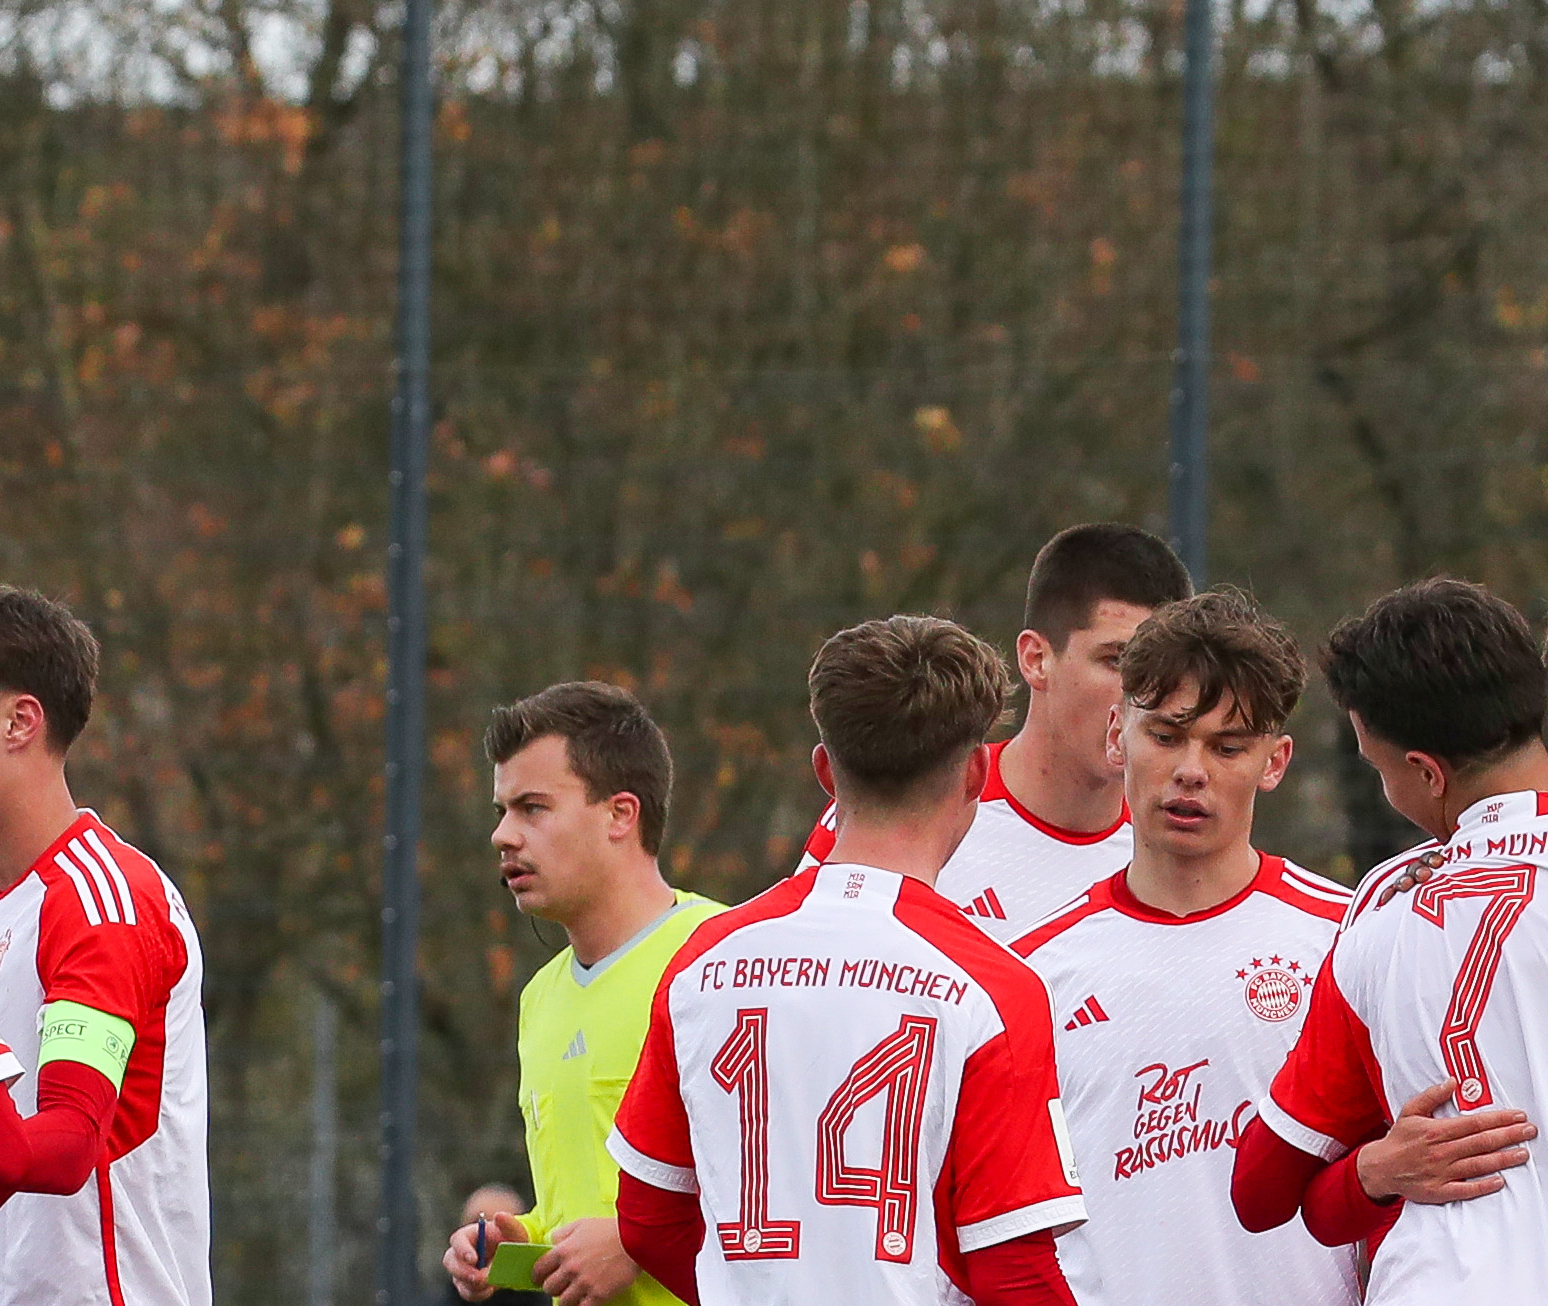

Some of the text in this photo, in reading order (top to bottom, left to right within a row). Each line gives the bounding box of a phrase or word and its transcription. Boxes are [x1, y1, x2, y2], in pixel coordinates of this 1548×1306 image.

[700, 958, 969, 1006] FC BAYERN MÜNCHEN
[1412, 863, 1537, 1113] 7
[43, 1023, 88, 1042] SPECT
[1134, 1058, 1211, 1111] ROT
[1134, 1083, 1202, 1139] GEGEN
[710, 1006, 938, 1265] 14
[1114, 1099, 1252, 1181] RASSISMUS
